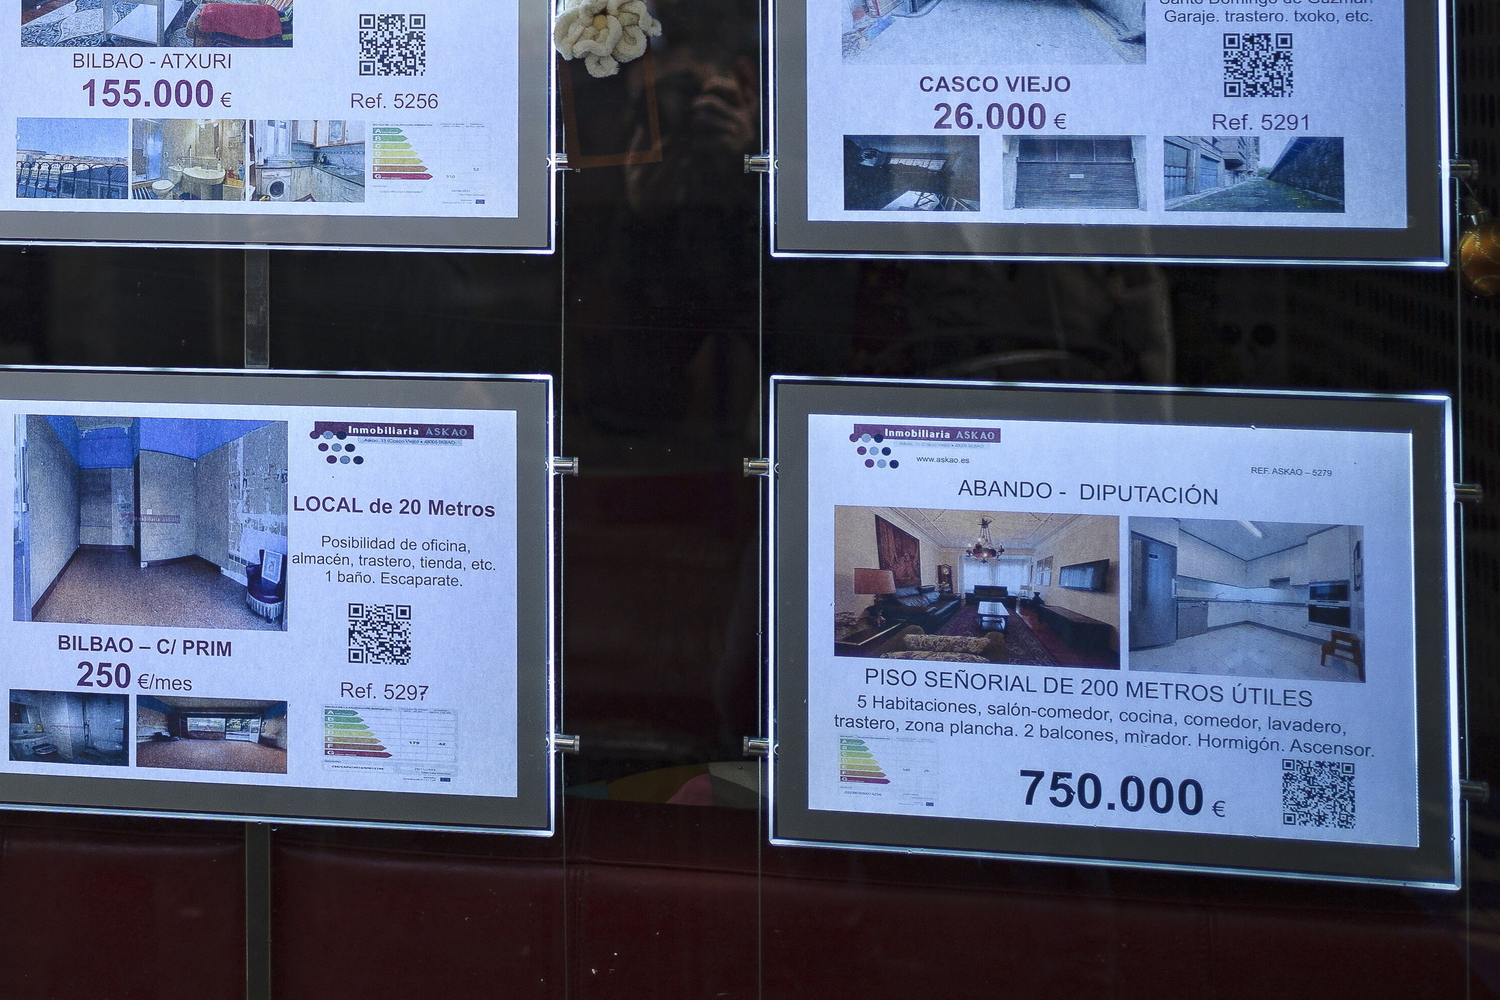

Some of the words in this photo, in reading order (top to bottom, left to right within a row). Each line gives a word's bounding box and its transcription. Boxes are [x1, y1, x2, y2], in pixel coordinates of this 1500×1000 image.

[73, 52, 144, 69] BILBAO
[160, 52, 231, 69] ATXURI
[82, 78, 214, 108] 155.000
[219, 91, 232, 108] €
[919, 75, 999, 93] CASCO
[1004, 75, 1071, 93] VIEJO
[350, 92, 386, 109] Ref.
[393, 92, 439, 109] 5256
[933, 102, 1047, 130] 26.000
[1053, 112, 1067, 130] €
[1212, 113, 1253, 131] Ref.
[1260, 113, 1309, 131] 5291
[348, 424, 419, 436] Inmobiliaria
[424, 426, 468, 437] ASKAO
[884, 427, 951, 439] Inmobiliaria
[955, 430, 995, 440] ASKAO
[915, 455, 970, 464] www.askao.es
[1250, 466, 1271, 475] REF.
[1271, 466, 1303, 476] ASKAO
[1311, 468, 1333, 477] 5279
[957, 479, 1053, 499] ABANDO
[1079, 483, 1218, 506] DIPUTACIÓN
[293, 495, 364, 513] LOCAL
[368, 497, 393, 514] de
[398, 498, 422, 515] 20
[428, 499, 496, 518] Metros
[321, 534, 396, 550] Posibilidad
[399, 537, 418, 551] de
[421, 538, 471, 555] oficina,
[57, 634, 134, 653] BILBAO
[156, 638, 177, 655] C/
[182, 639, 232, 657] PRIM
[76, 660, 131, 689] 250
[136, 672, 193, 692] €/mes
[340, 681, 377, 699] Ref.
[383, 683, 429, 701] 5297
[865, 667, 917, 687] PISO
[923, 668, 1038, 693] SEÑORIAL
[1043, 676, 1074, 695] DE
[1080, 678, 1119, 697] 200
[1125, 680, 1224, 703] METROS
[1231, 682, 1313, 708] ÚTILES
[857, 694, 867, 709] 5
[872, 694, 982, 717] Habitaciones,
[986, 701, 1113, 724] salón-comedor,
[1118, 708, 1178, 727] cocina,
[1183, 713, 1261, 732] comedor,
[1267, 715, 1347, 737] lavadero,
[1019, 769, 1204, 816] 750.000
[1211, 799, 1226, 818] €
